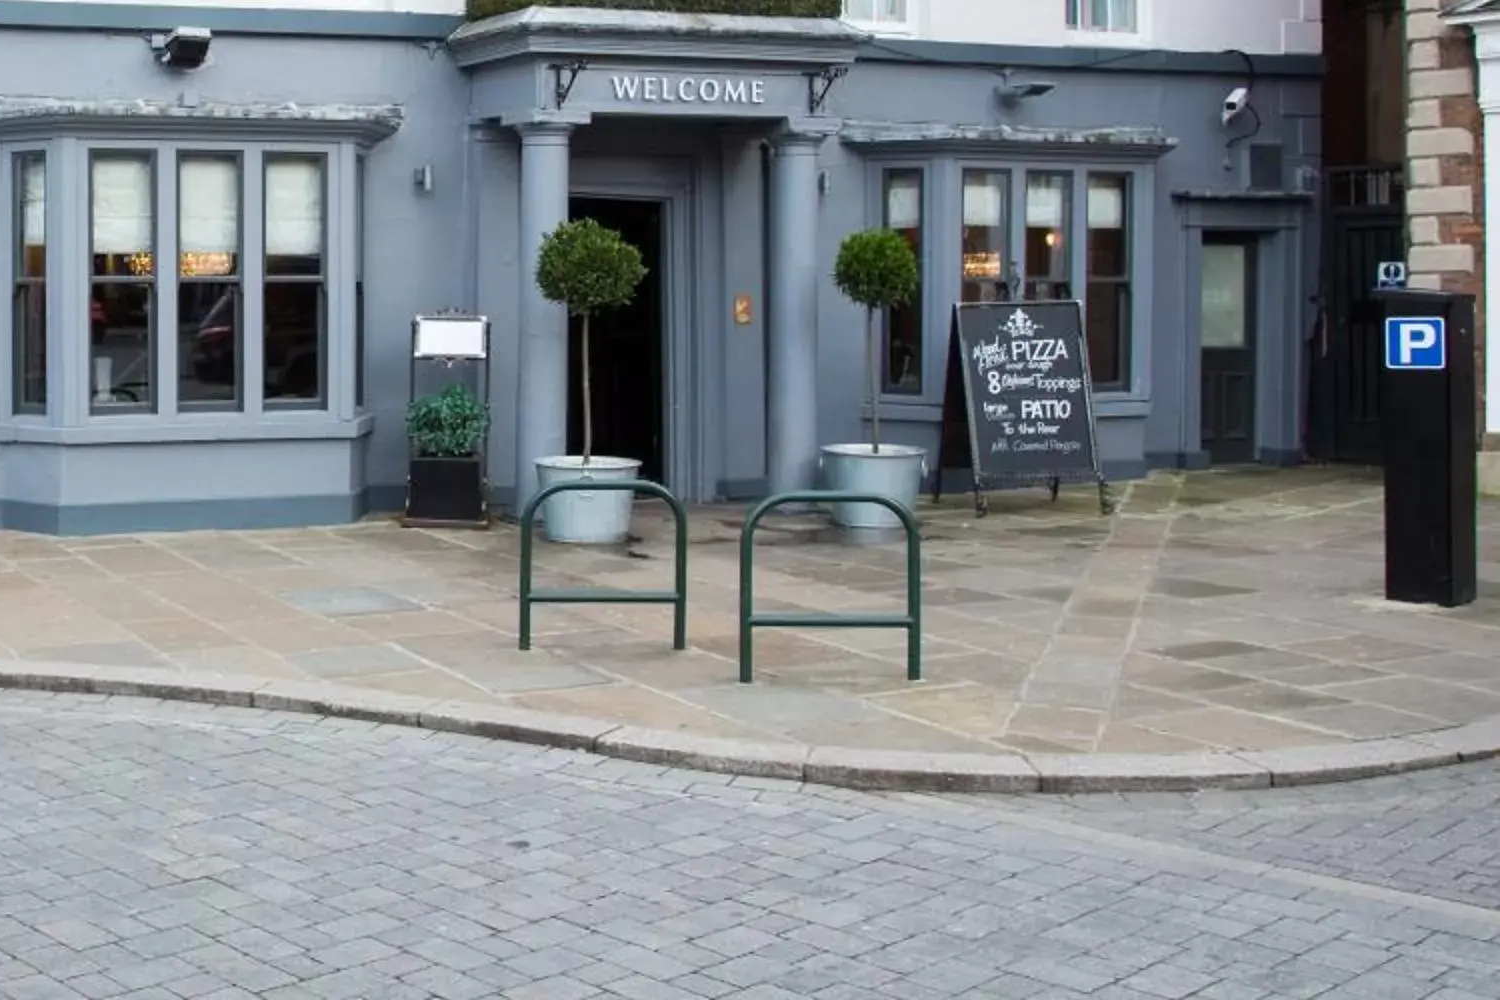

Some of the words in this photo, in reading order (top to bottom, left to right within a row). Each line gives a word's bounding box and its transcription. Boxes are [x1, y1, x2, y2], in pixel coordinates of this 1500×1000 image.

[611, 75, 765, 104] WELCOME
[1011, 338, 1069, 361] PIZZA
[1399, 323, 1436, 365] P
[987, 370, 1001, 394] 8
[1032, 373, 1081, 393] Toppings
[1021, 399, 1071, 419] PATIO
[1002, 422, 1015, 435] To
[1018, 422, 1036, 435] the
